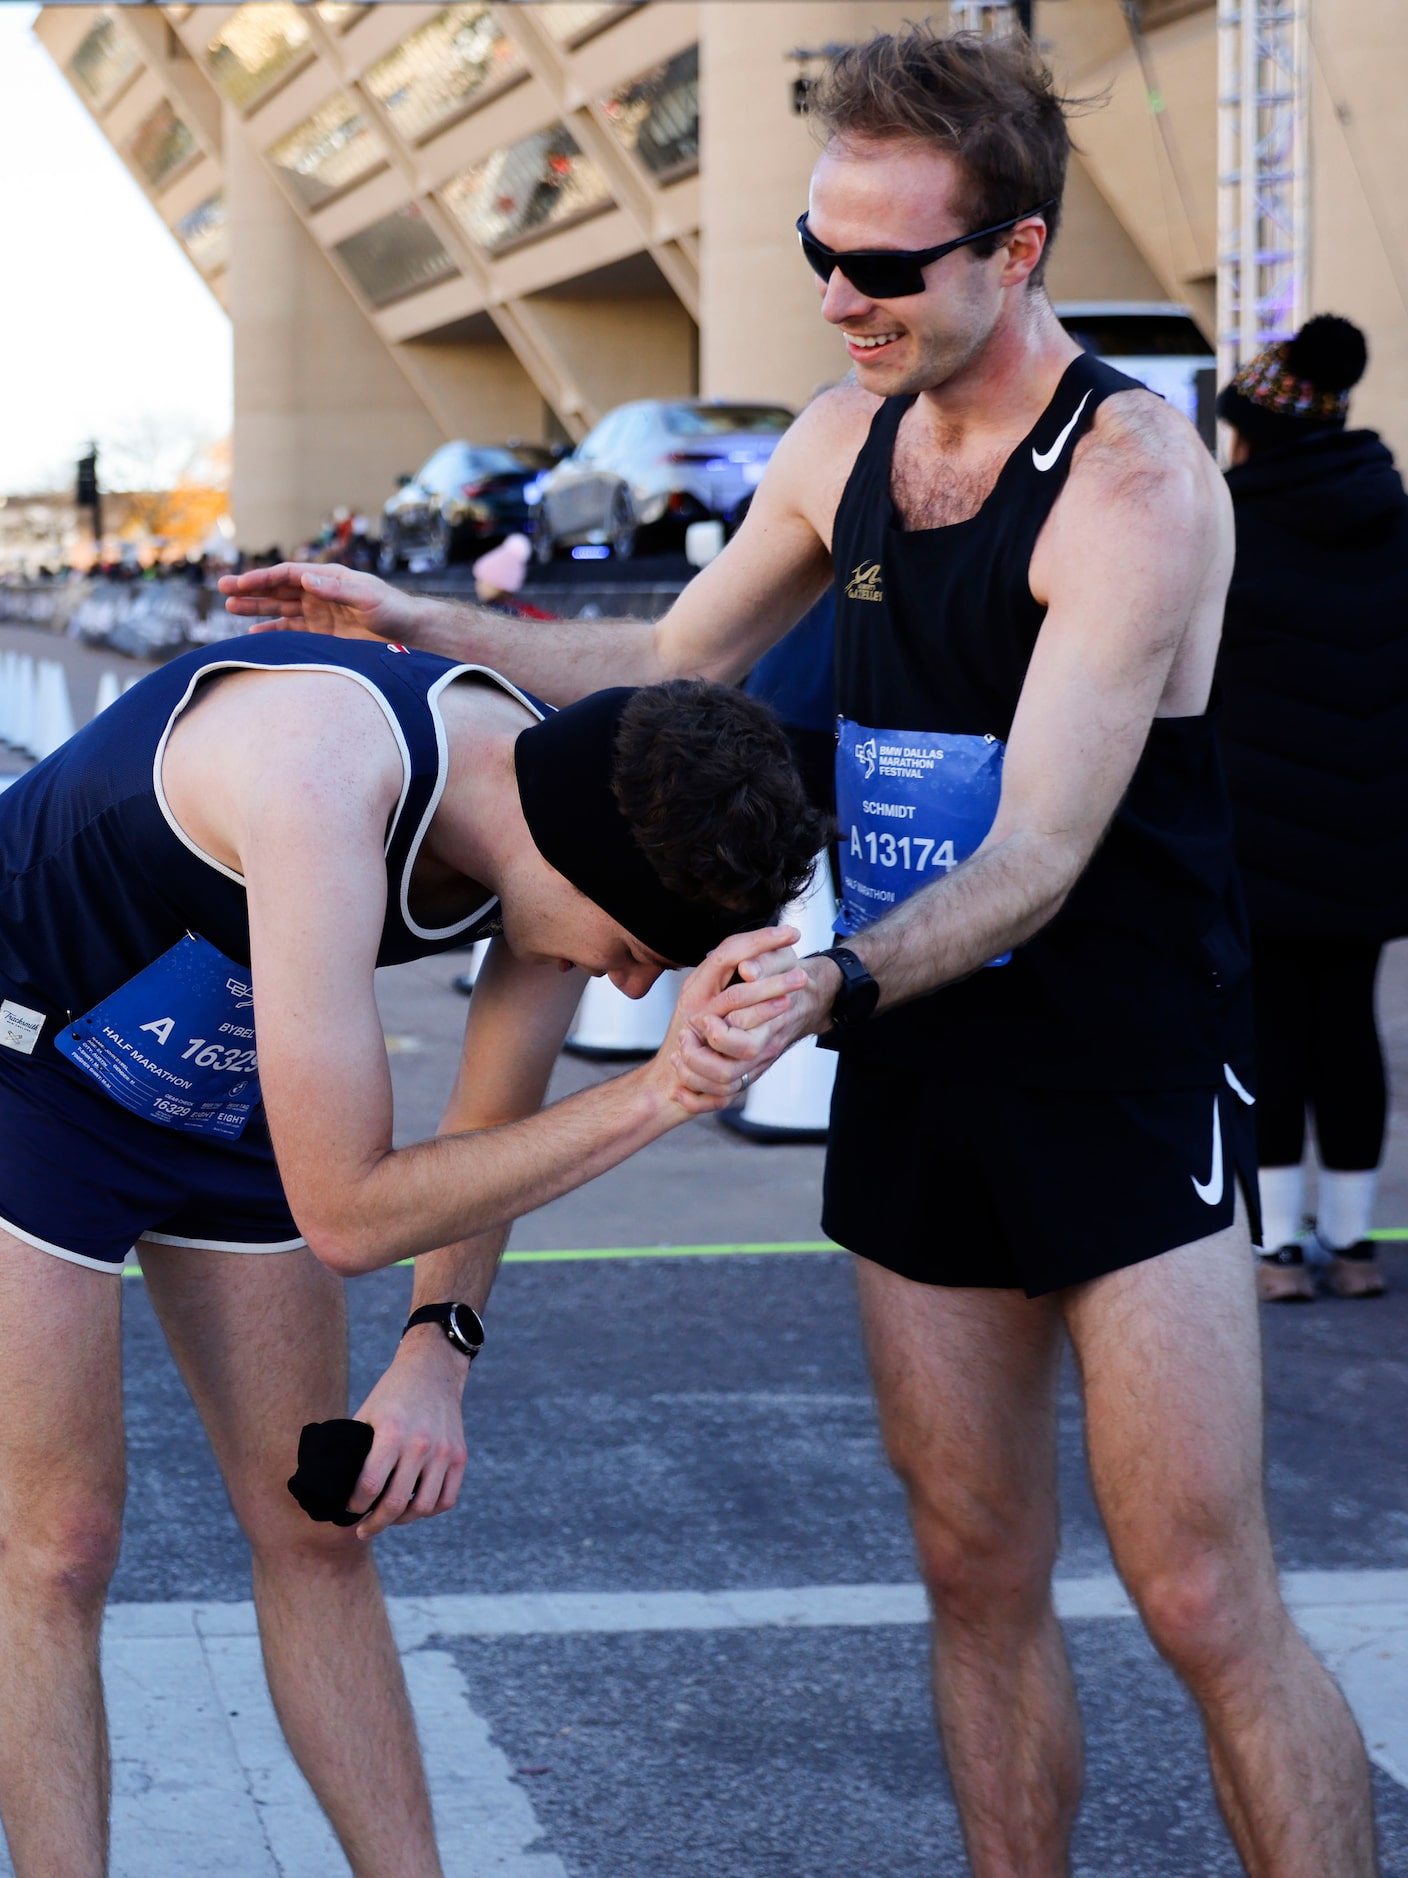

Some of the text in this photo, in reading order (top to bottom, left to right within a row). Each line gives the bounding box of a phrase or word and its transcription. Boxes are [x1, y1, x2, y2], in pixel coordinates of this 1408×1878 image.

[879, 746, 945, 760] BMW DALLAS
[879, 756, 935, 769] MARATHON
[879, 766, 924, 778] FESTIVAL
[862, 800, 916, 819] SCHMIDT
[850, 824, 959, 873] A 13174
[3, 1009, 40, 1031] Tracksmith
[218, 1022, 256, 1039] BYBEL
[139, 1016, 258, 1073] A 16329
[103, 1026, 193, 1090] HALF MARATHON
[153, 1098, 192, 1117] 16329
[217, 1112, 245, 1125] EIGHT
